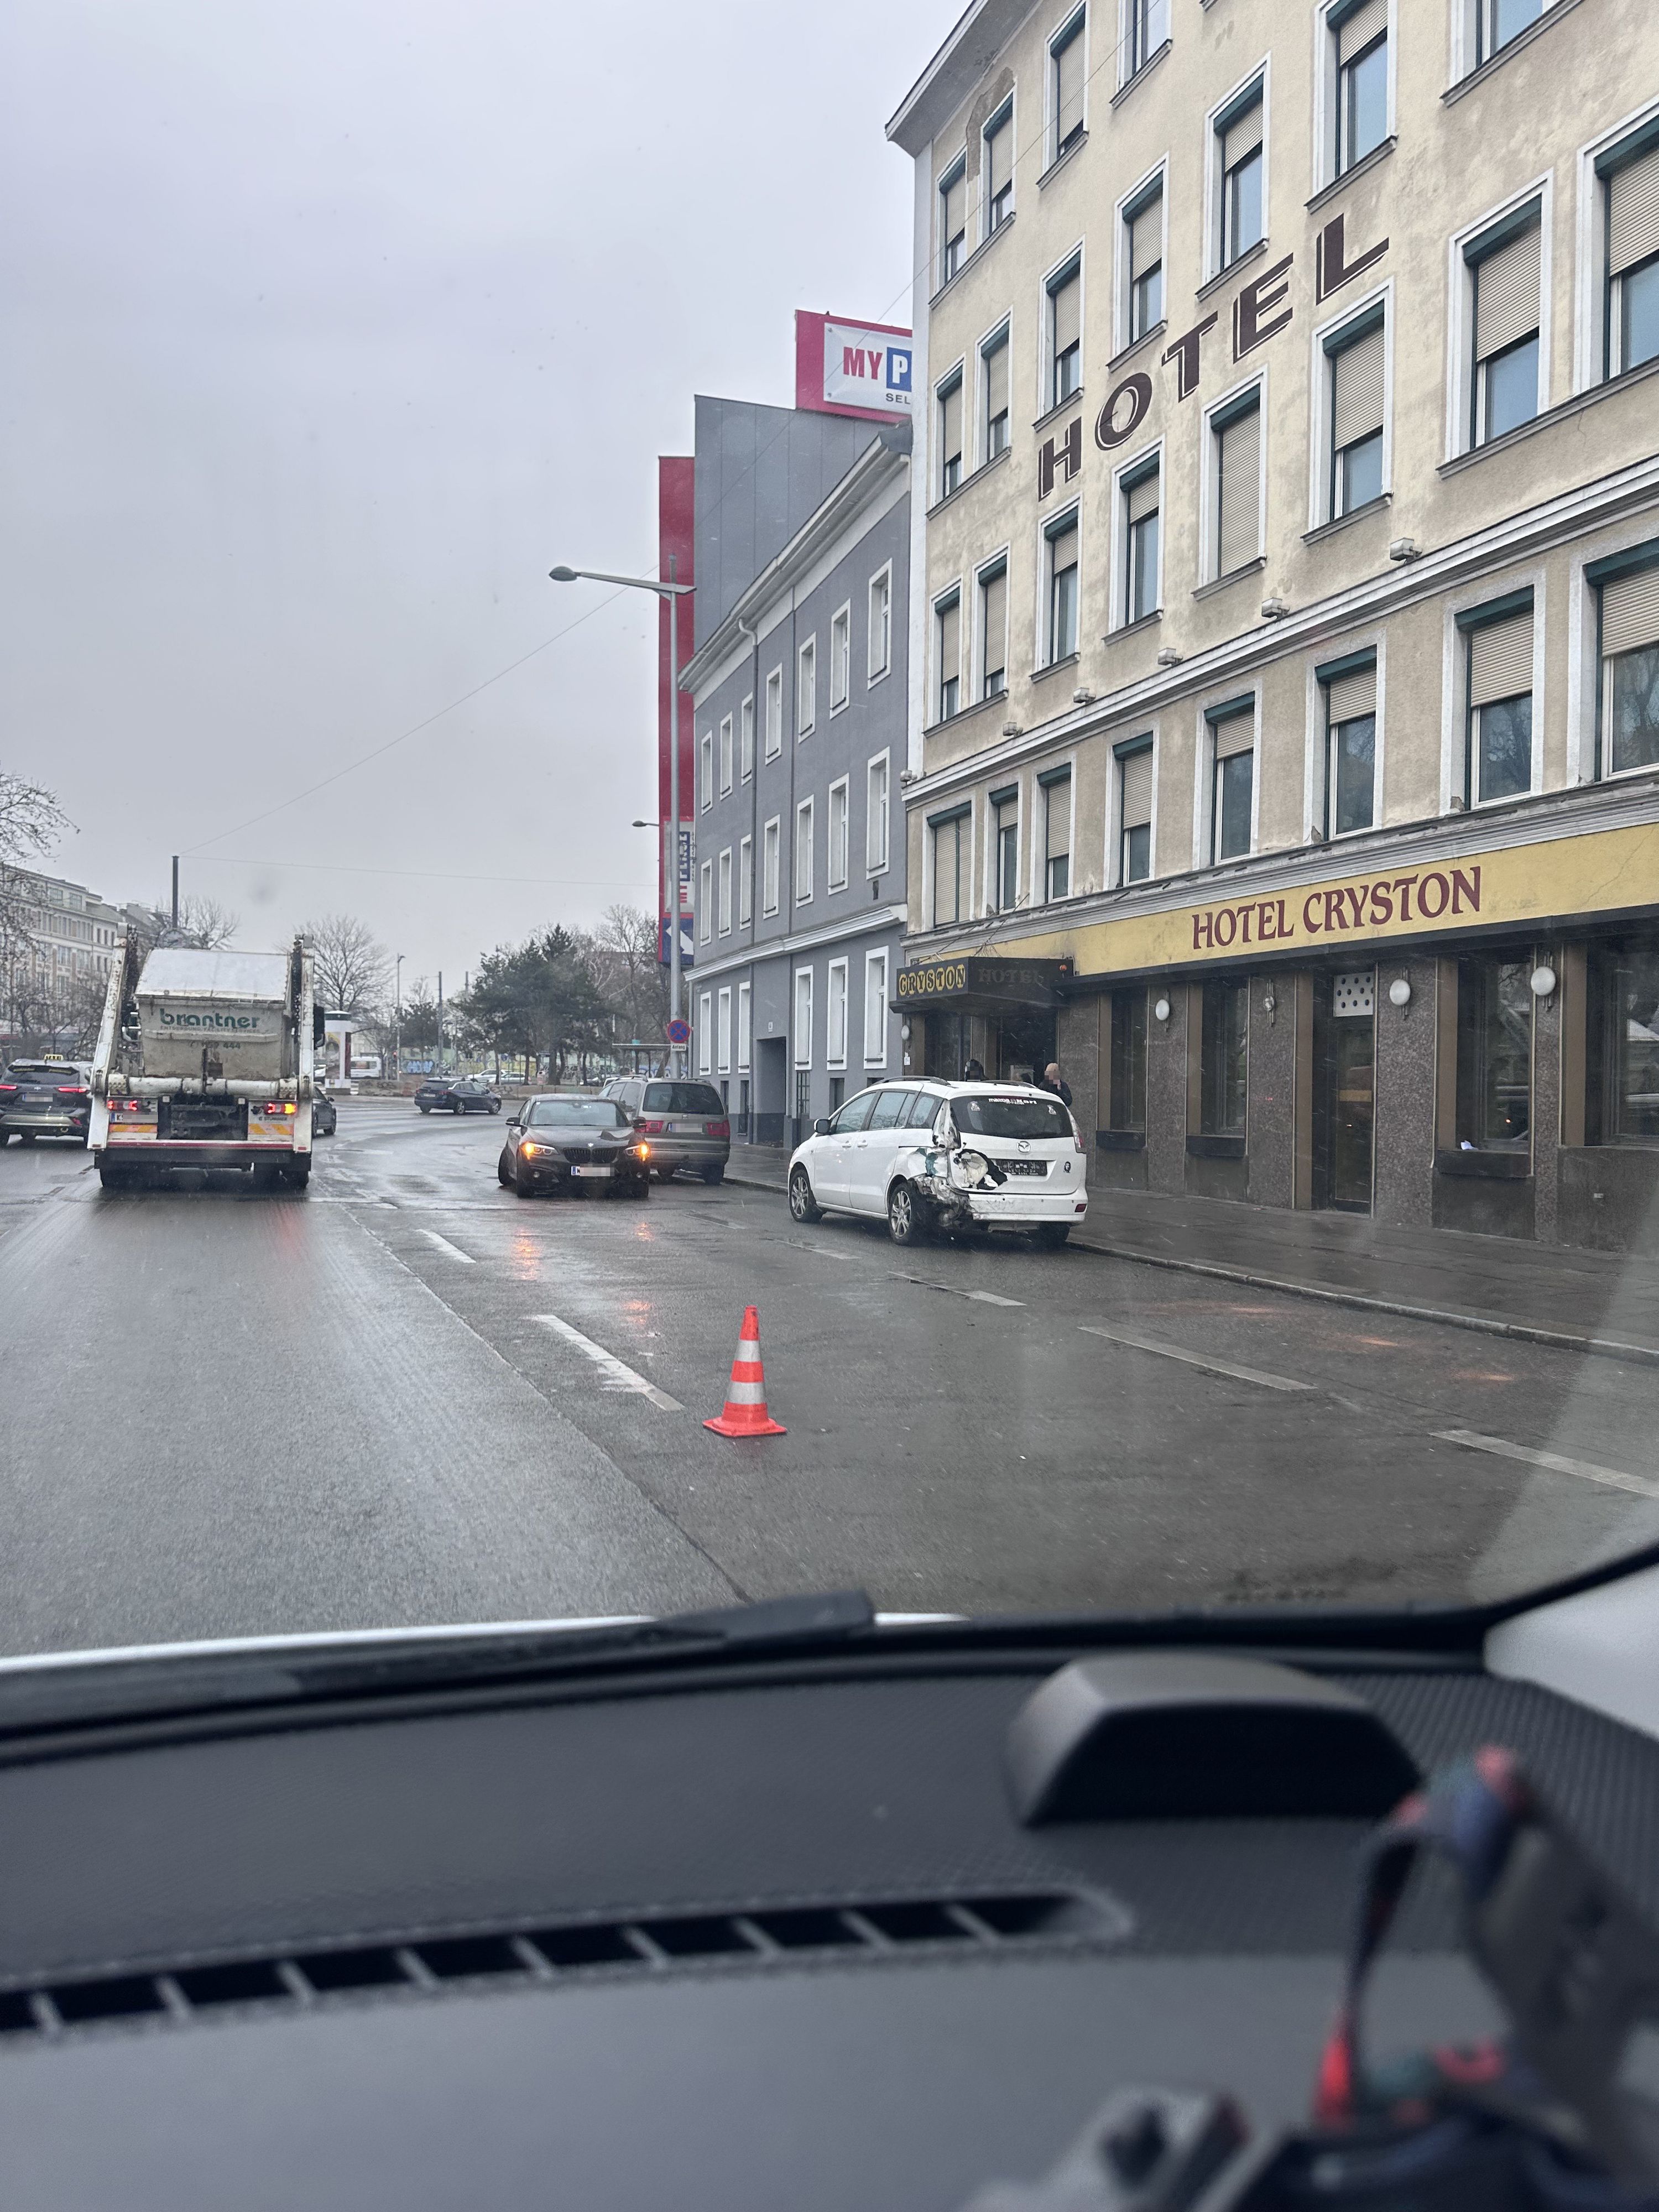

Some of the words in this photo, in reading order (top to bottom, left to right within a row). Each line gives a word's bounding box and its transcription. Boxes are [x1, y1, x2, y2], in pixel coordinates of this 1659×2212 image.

[1039, 213, 1389, 501] HOTEL
[1192, 900, 1294, 950] HOTEL
[1303, 866, 1481, 933] CRYSTON
[160, 1008, 260, 1027] brantner
